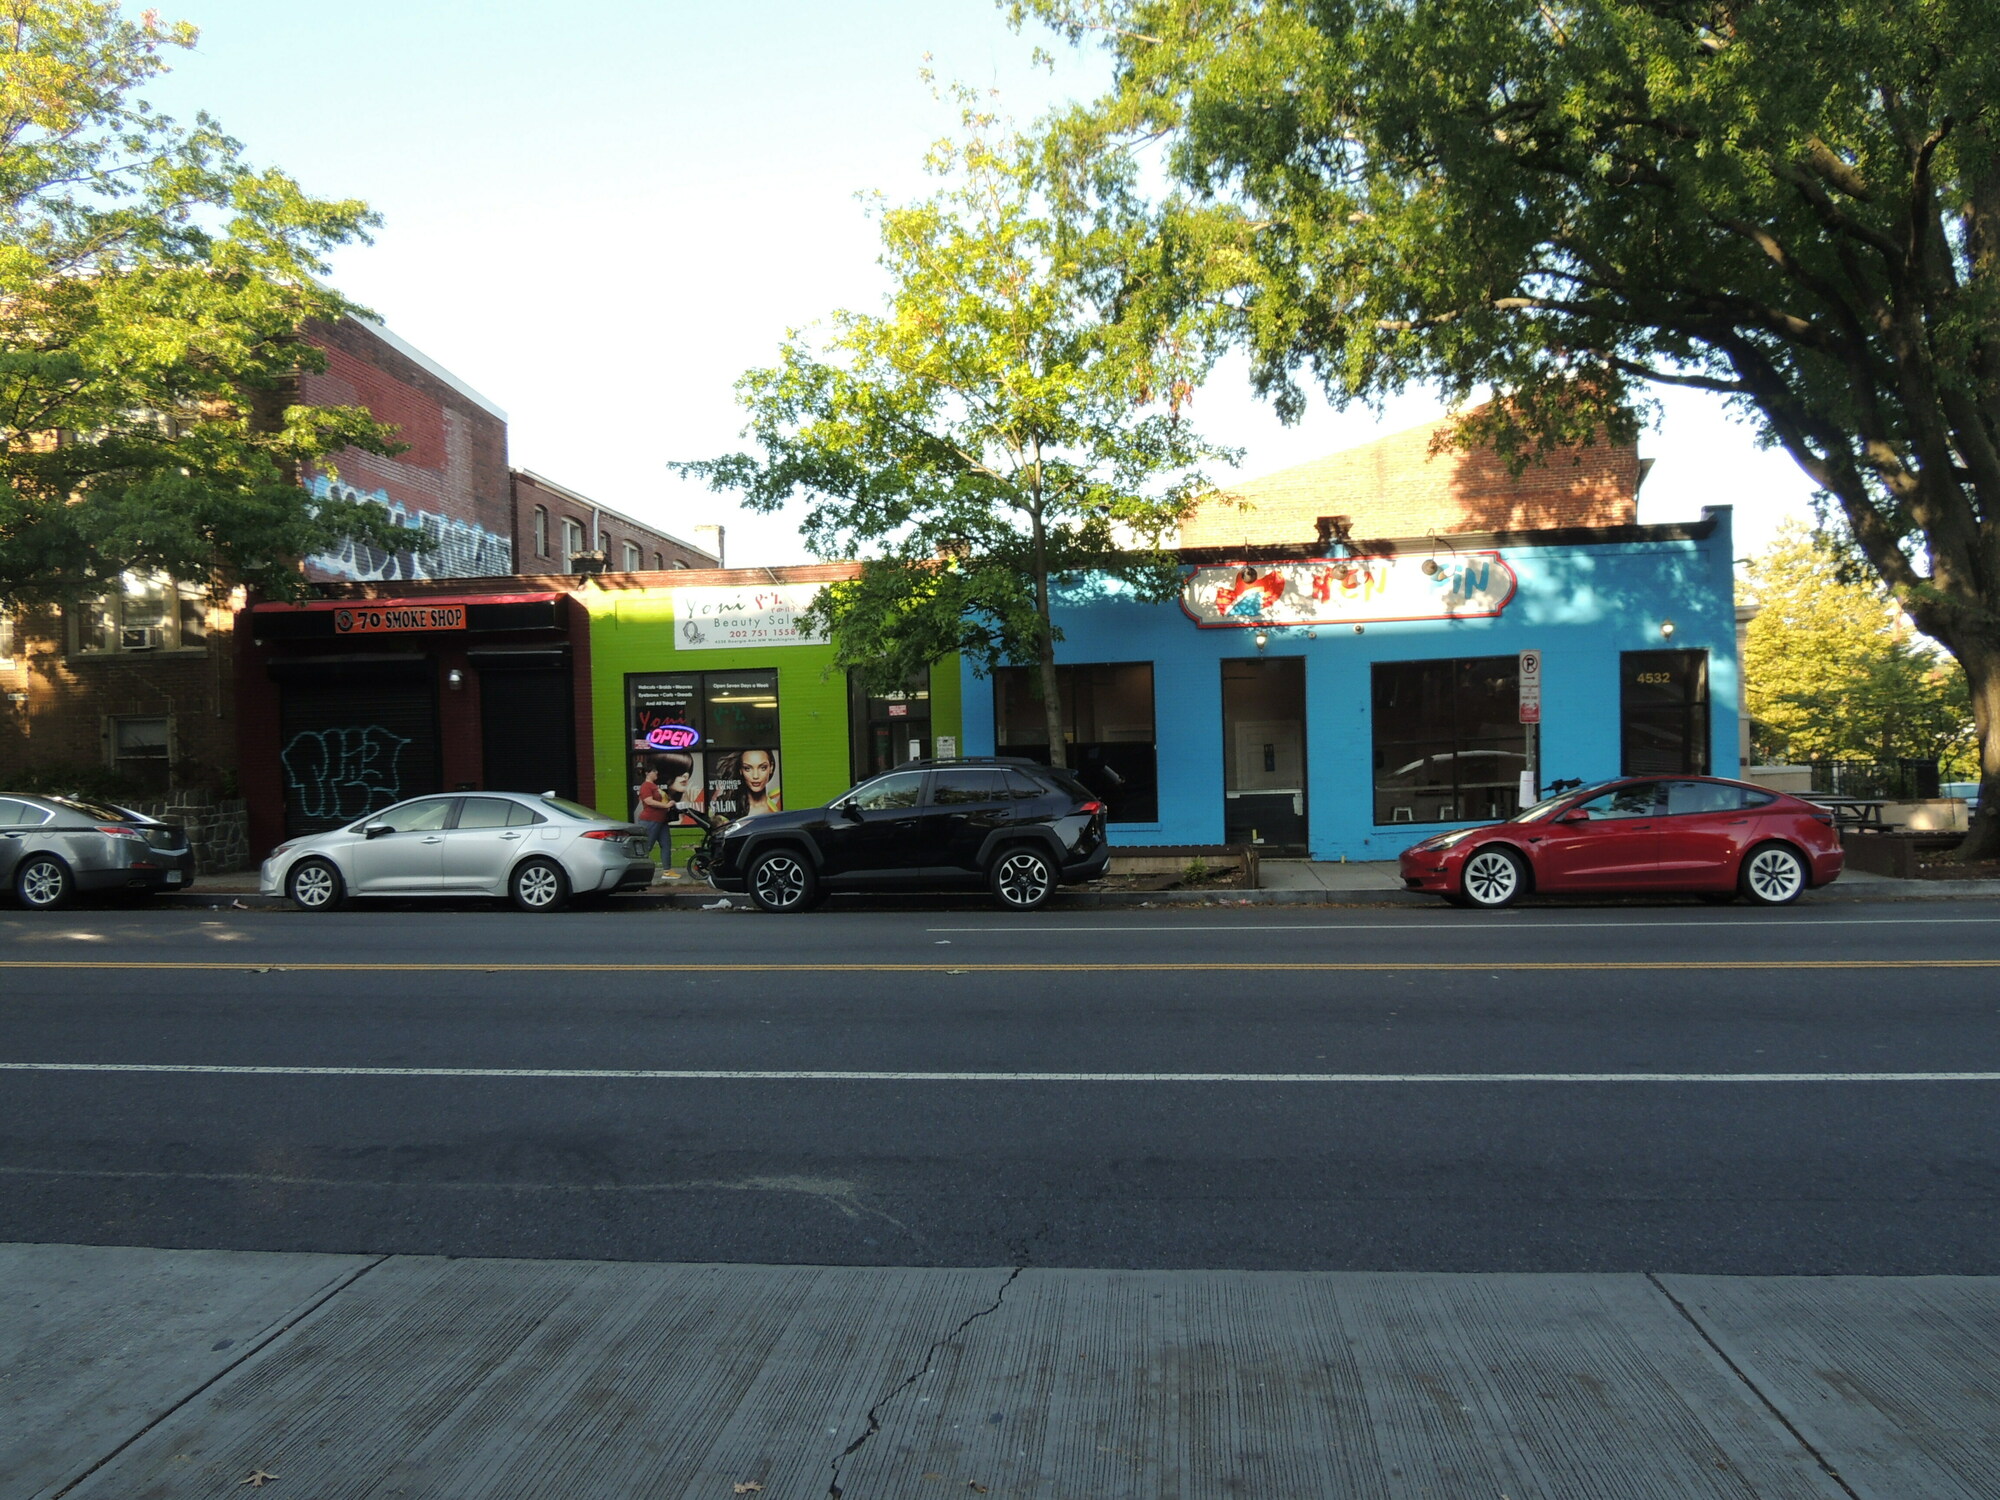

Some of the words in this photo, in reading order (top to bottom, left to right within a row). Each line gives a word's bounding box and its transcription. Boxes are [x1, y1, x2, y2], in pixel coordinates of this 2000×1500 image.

[686, 594, 746, 619] Yoni
[357, 612, 381, 630] 70
[385, 610, 427, 629] SMOKE
[430, 608, 462, 627] SHOP
[714, 617, 760, 628] Beauty
[768, 613, 797, 626] Sal
[729, 630, 748, 638] 202
[751, 629, 768, 637] 751
[773, 628, 797, 636] 1558
[1636, 672, 1671, 684] 4532
[640, 710, 686, 731] Yoni
[650, 728, 693, 747] OPEN
[710, 799, 737, 813] SALON
